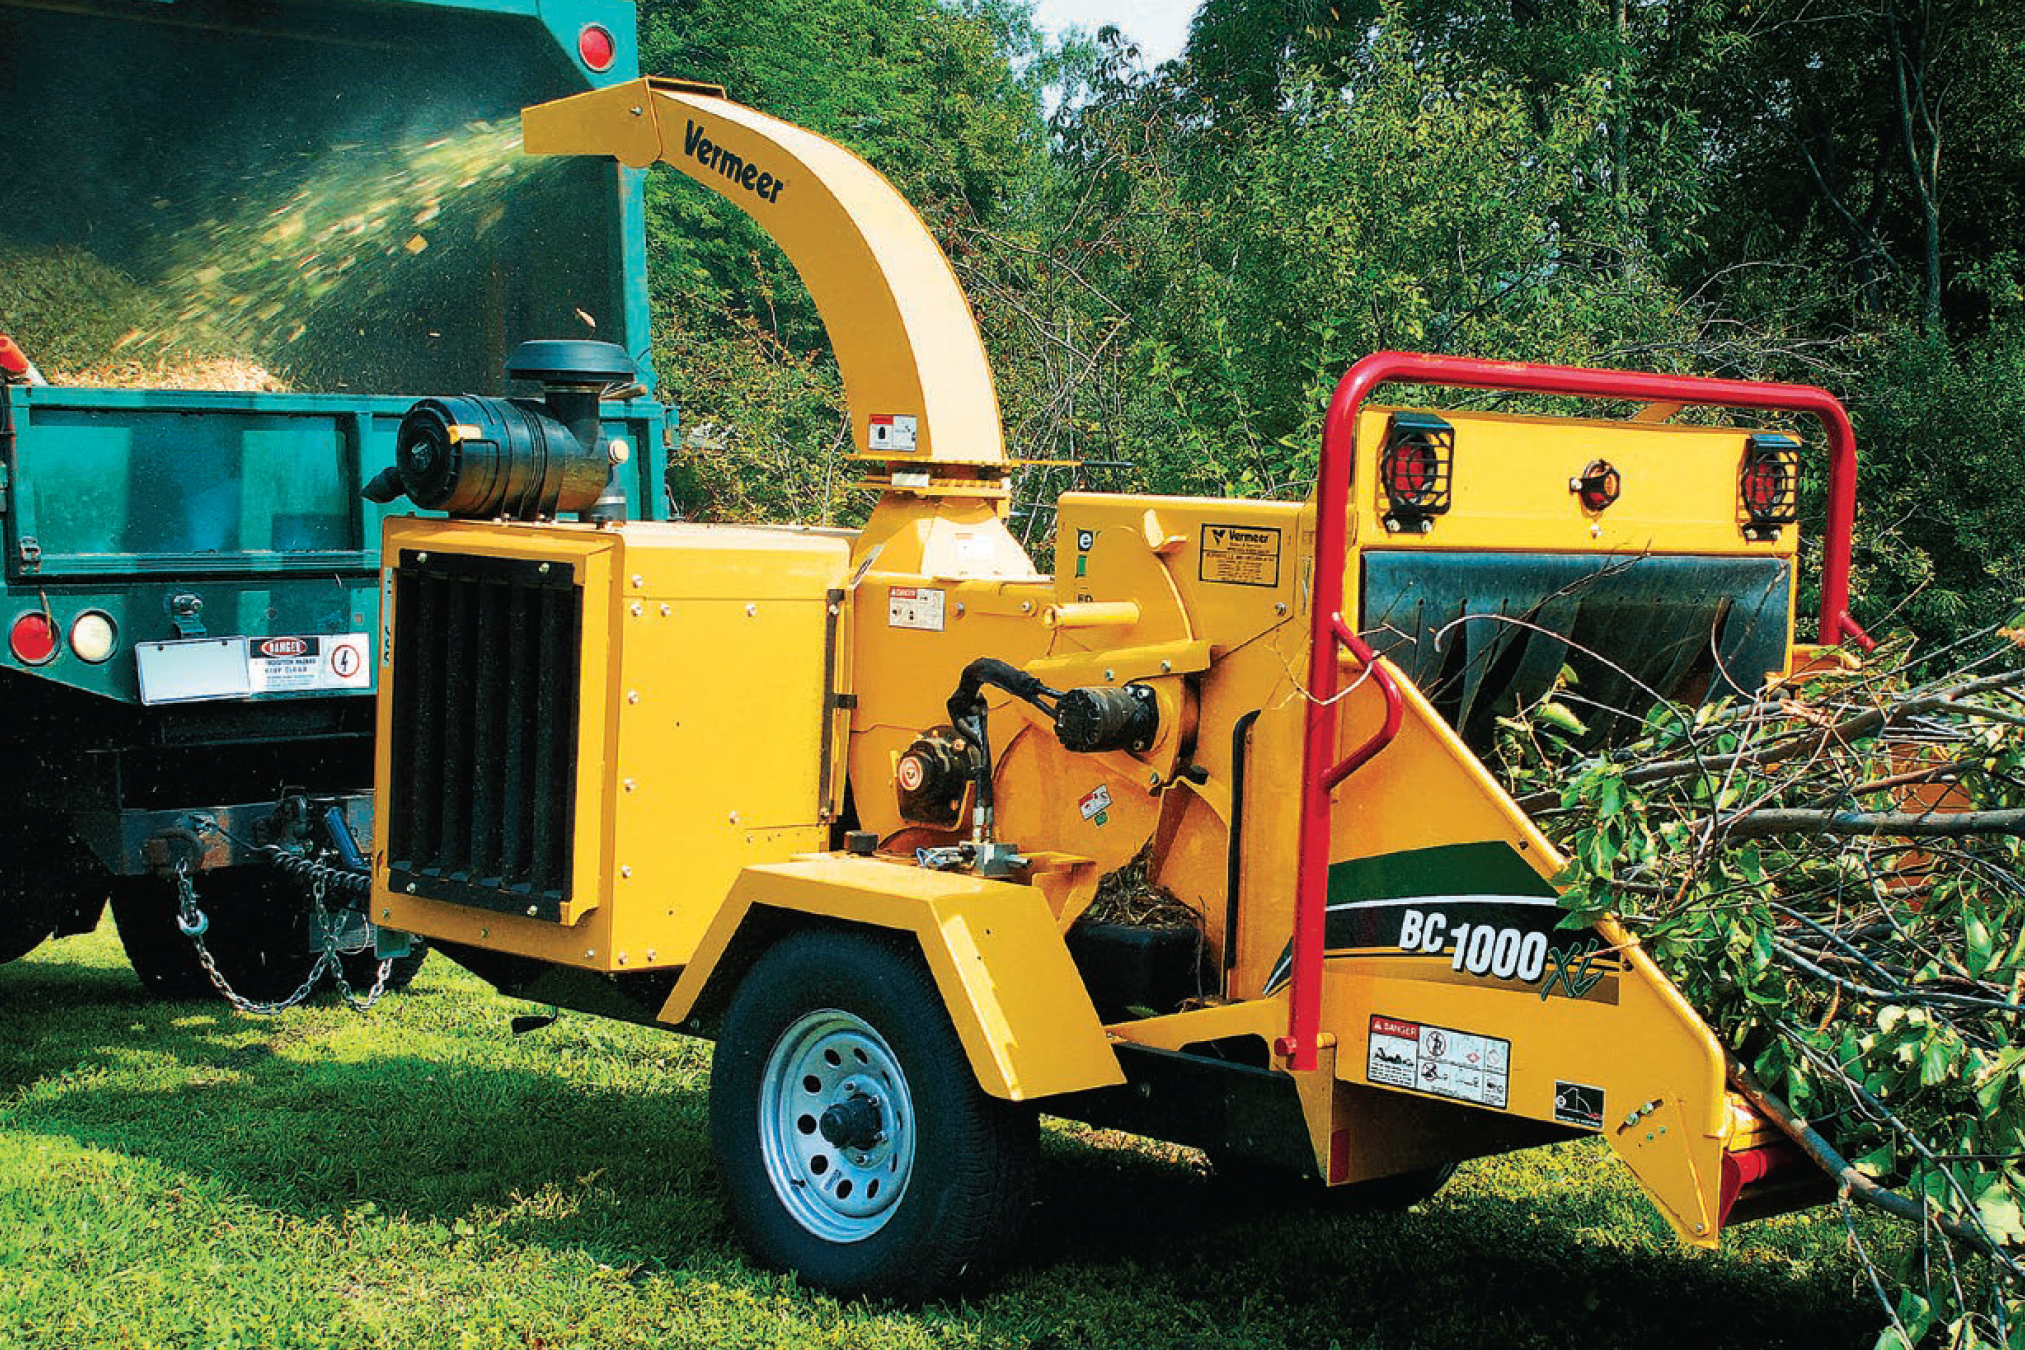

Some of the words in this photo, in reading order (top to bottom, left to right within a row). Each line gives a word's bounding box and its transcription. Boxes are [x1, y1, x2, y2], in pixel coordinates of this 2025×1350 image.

[685, 119, 784, 203] Vermeer
[1229, 529, 1268, 544] Vermeer
[1384, 1022, 1417, 1036] DANGER
